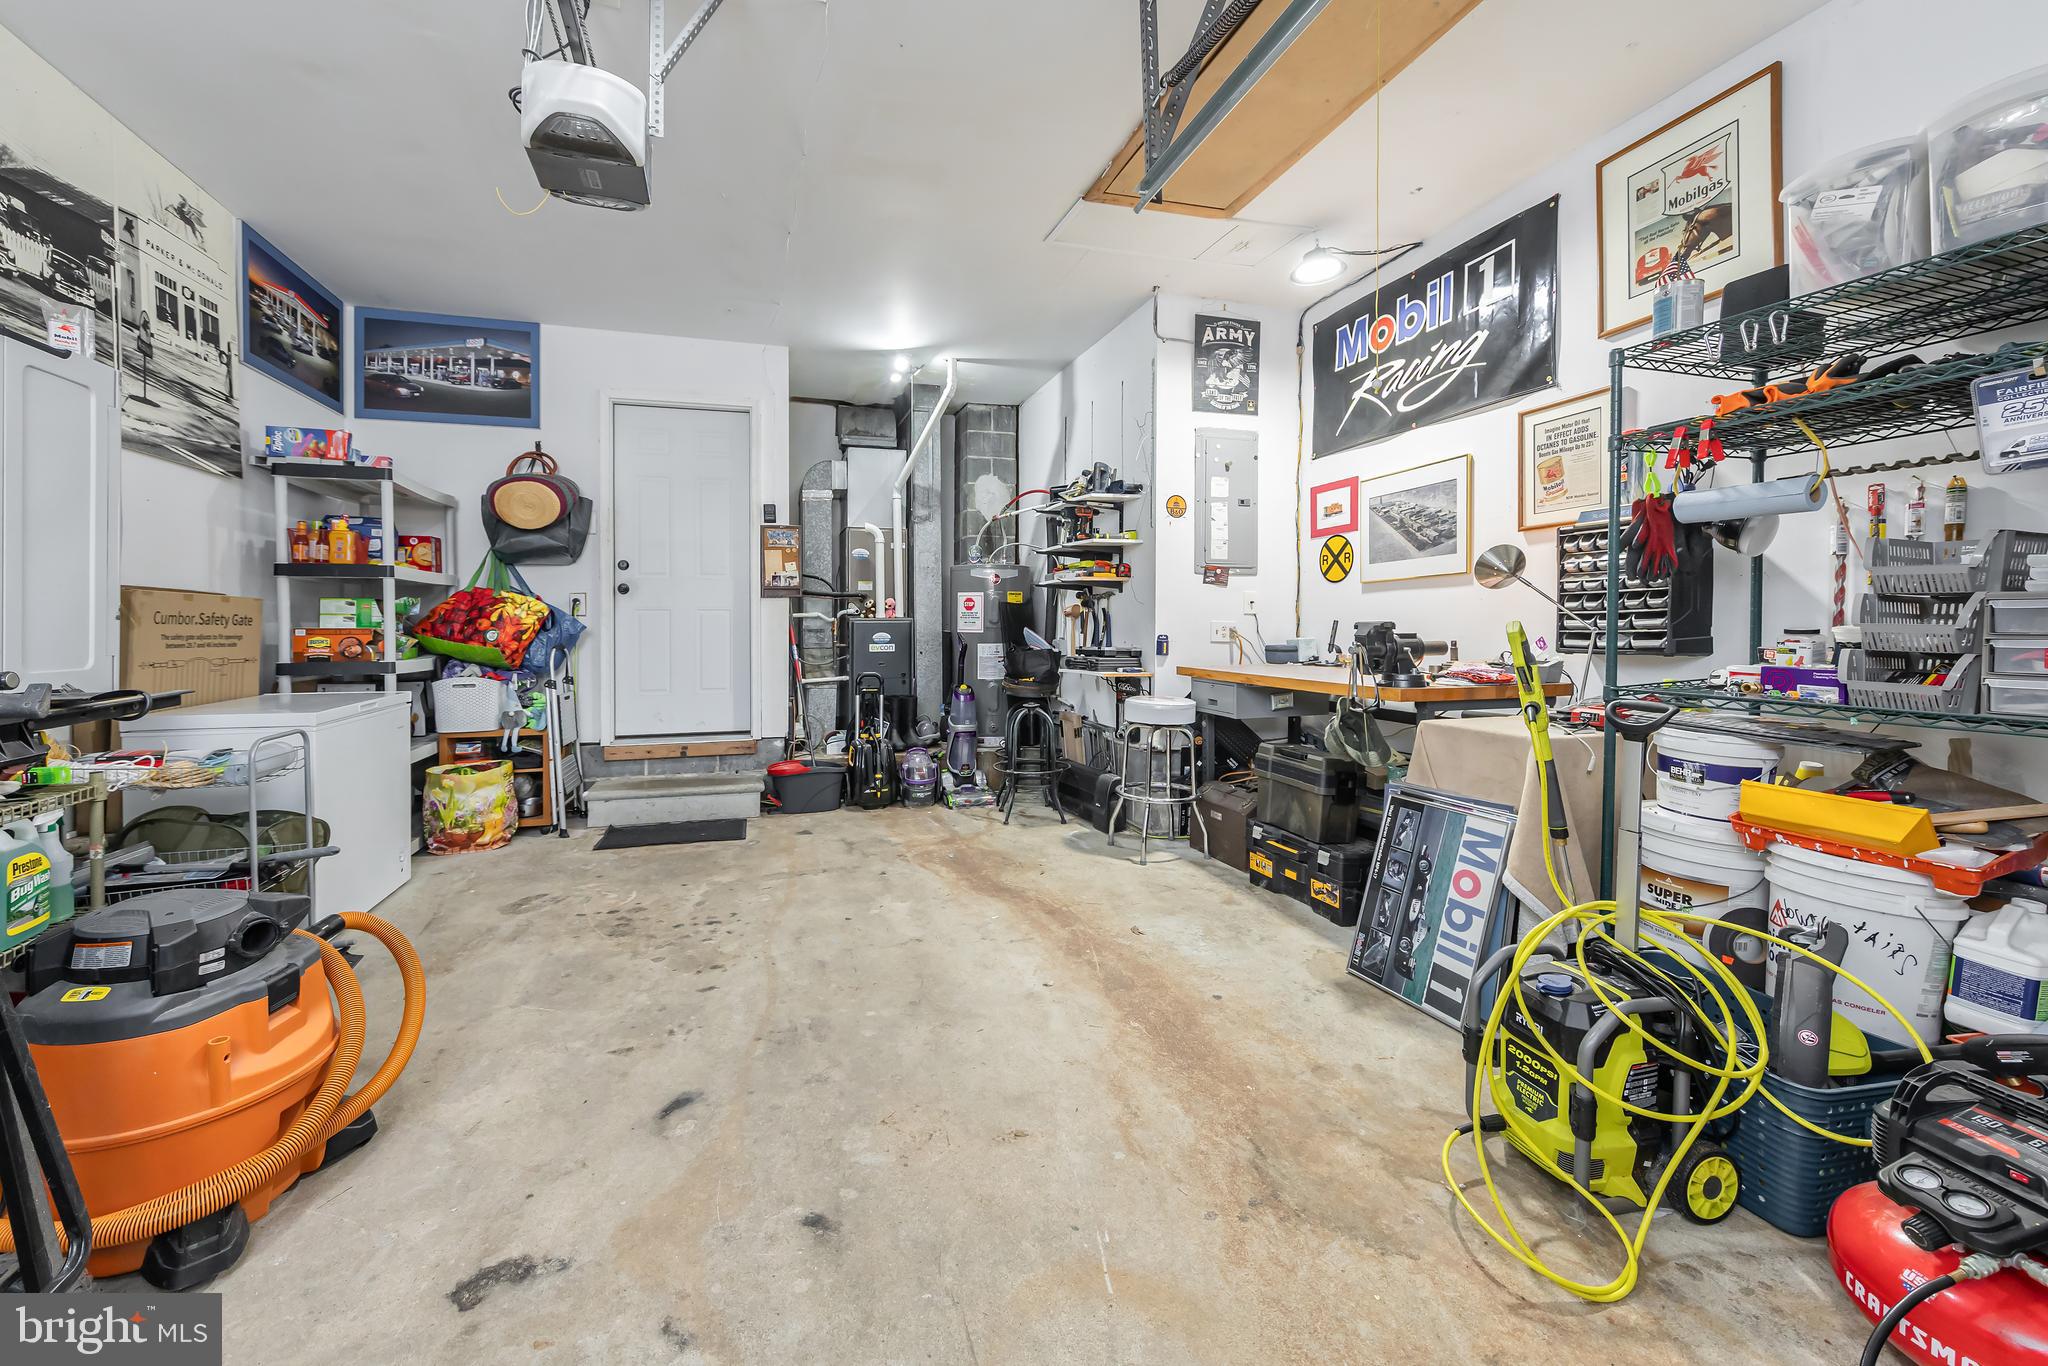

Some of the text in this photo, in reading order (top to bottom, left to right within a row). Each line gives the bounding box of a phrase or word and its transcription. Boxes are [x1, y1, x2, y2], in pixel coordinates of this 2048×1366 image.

[1668, 178, 1723, 212] Mobilgas
[145, 239, 176, 262] PARKER
[178, 258, 184, 268] &
[1334, 270, 1455, 373] Mobil
[1201, 327, 1256, 347] ARMY
[1336, 329, 1489, 436] Racing
[271, 430, 284, 453] Ziploc
[1536, 440, 1560, 452] OCTANES
[1569, 431, 1599, 444] GASOLINE.
[1554, 429, 1572, 440] EFFECT
[1573, 425, 1589, 435] ADDS
[1322, 552, 1351, 566] R R
[199, 612, 230, 629] Safety
[231, 614, 254, 627] Gate
[1670, 766, 1691, 777] BEHR
[12, 856, 42, 876] Prestone
[10, 880, 34, 903] Bug
[1647, 883, 1693, 907] SUPER
[1430, 826, 1504, 1003] Mobil 1
[1844, 1000, 1887, 1016] CONGELER
[1516, 1085, 1544, 1107] ELECTRIC
[1517, 1079, 1545, 1102] PREMIUM
[1845, 1270, 1982, 1366] CRATSM
